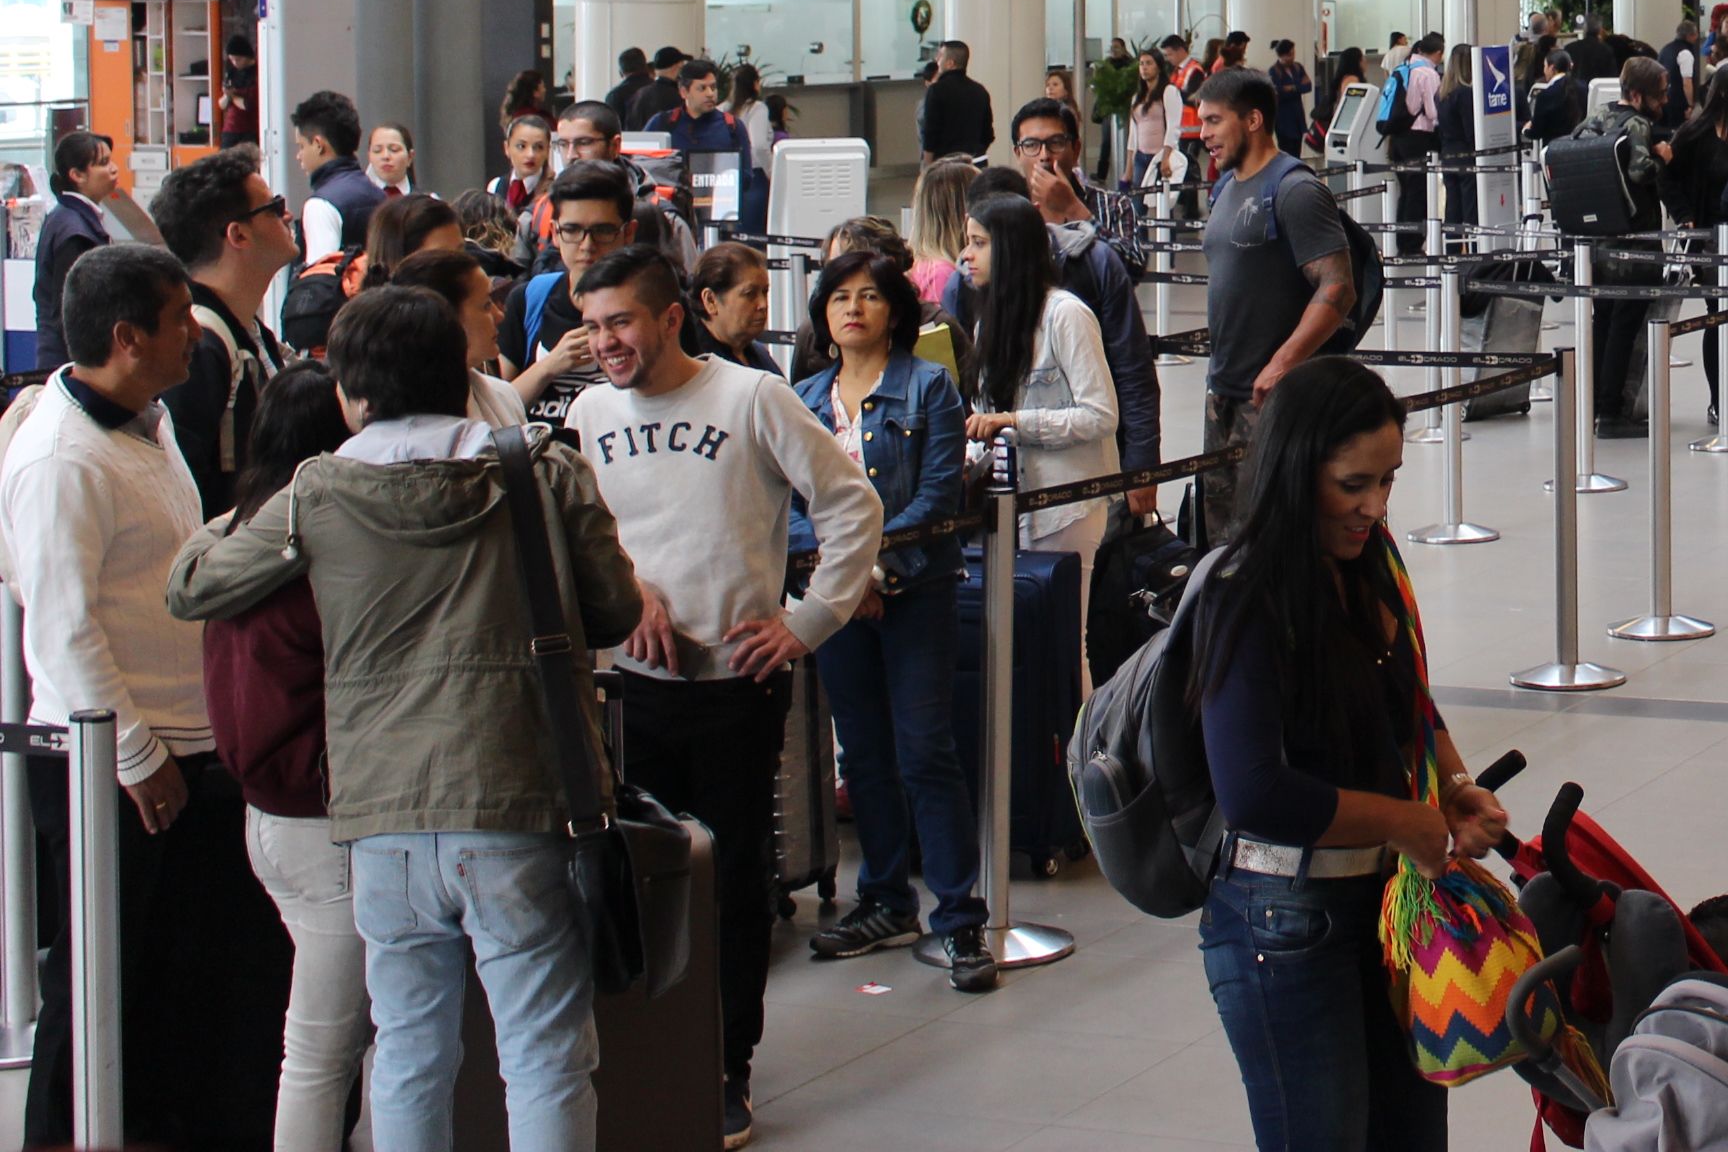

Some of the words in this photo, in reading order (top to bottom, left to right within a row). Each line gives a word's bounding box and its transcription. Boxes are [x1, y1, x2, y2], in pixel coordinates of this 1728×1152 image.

[1487, 92, 1507, 108] tame
[692, 173, 735, 188] ENTRADA
[530, 396, 571, 418] adi
[597, 421, 730, 465] FITCH
